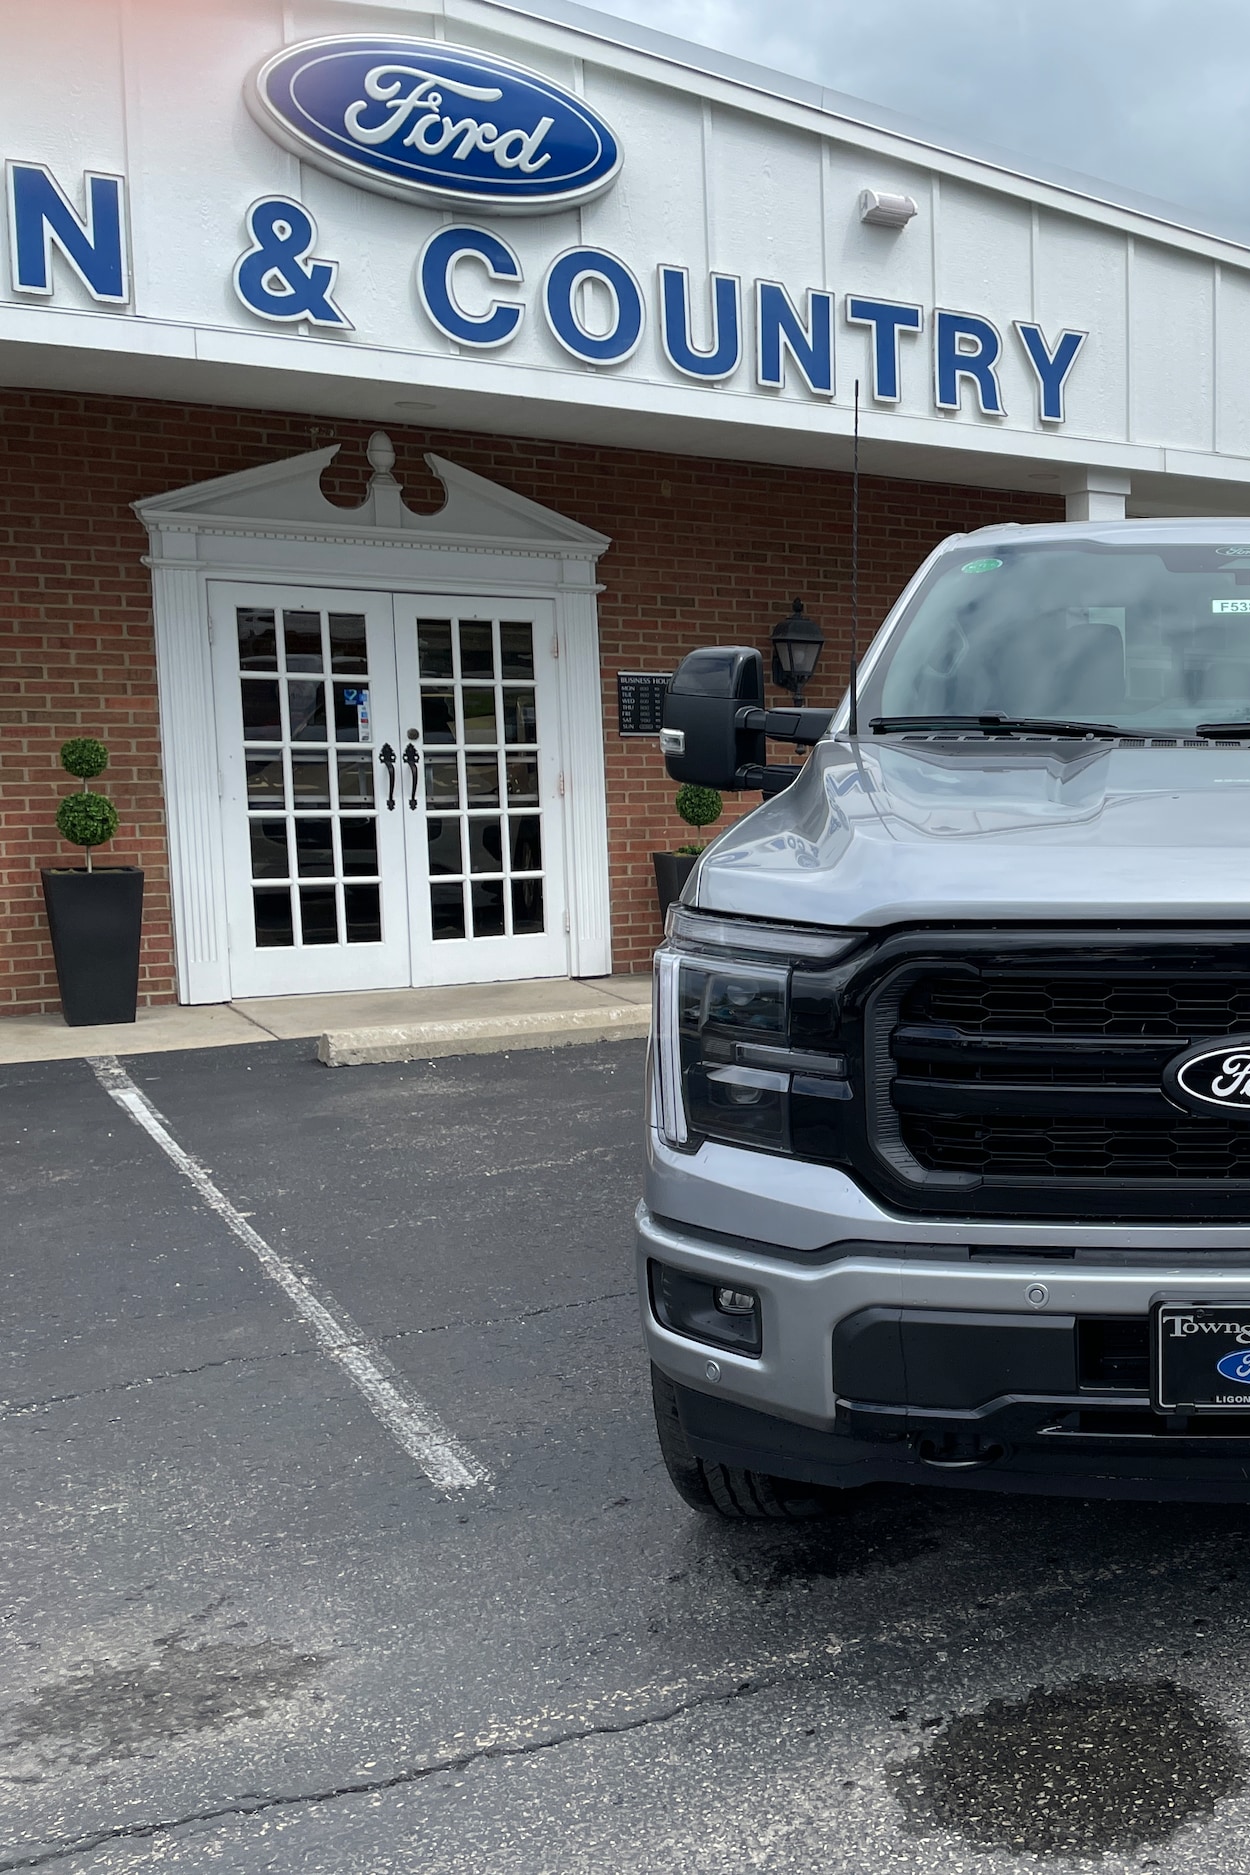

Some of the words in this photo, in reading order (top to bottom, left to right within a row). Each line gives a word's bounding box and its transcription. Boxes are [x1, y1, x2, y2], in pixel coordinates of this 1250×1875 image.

[344, 64, 555, 174] Ford
[234, 194, 356, 332] &
[417, 222, 1089, 423] COUNTRY
